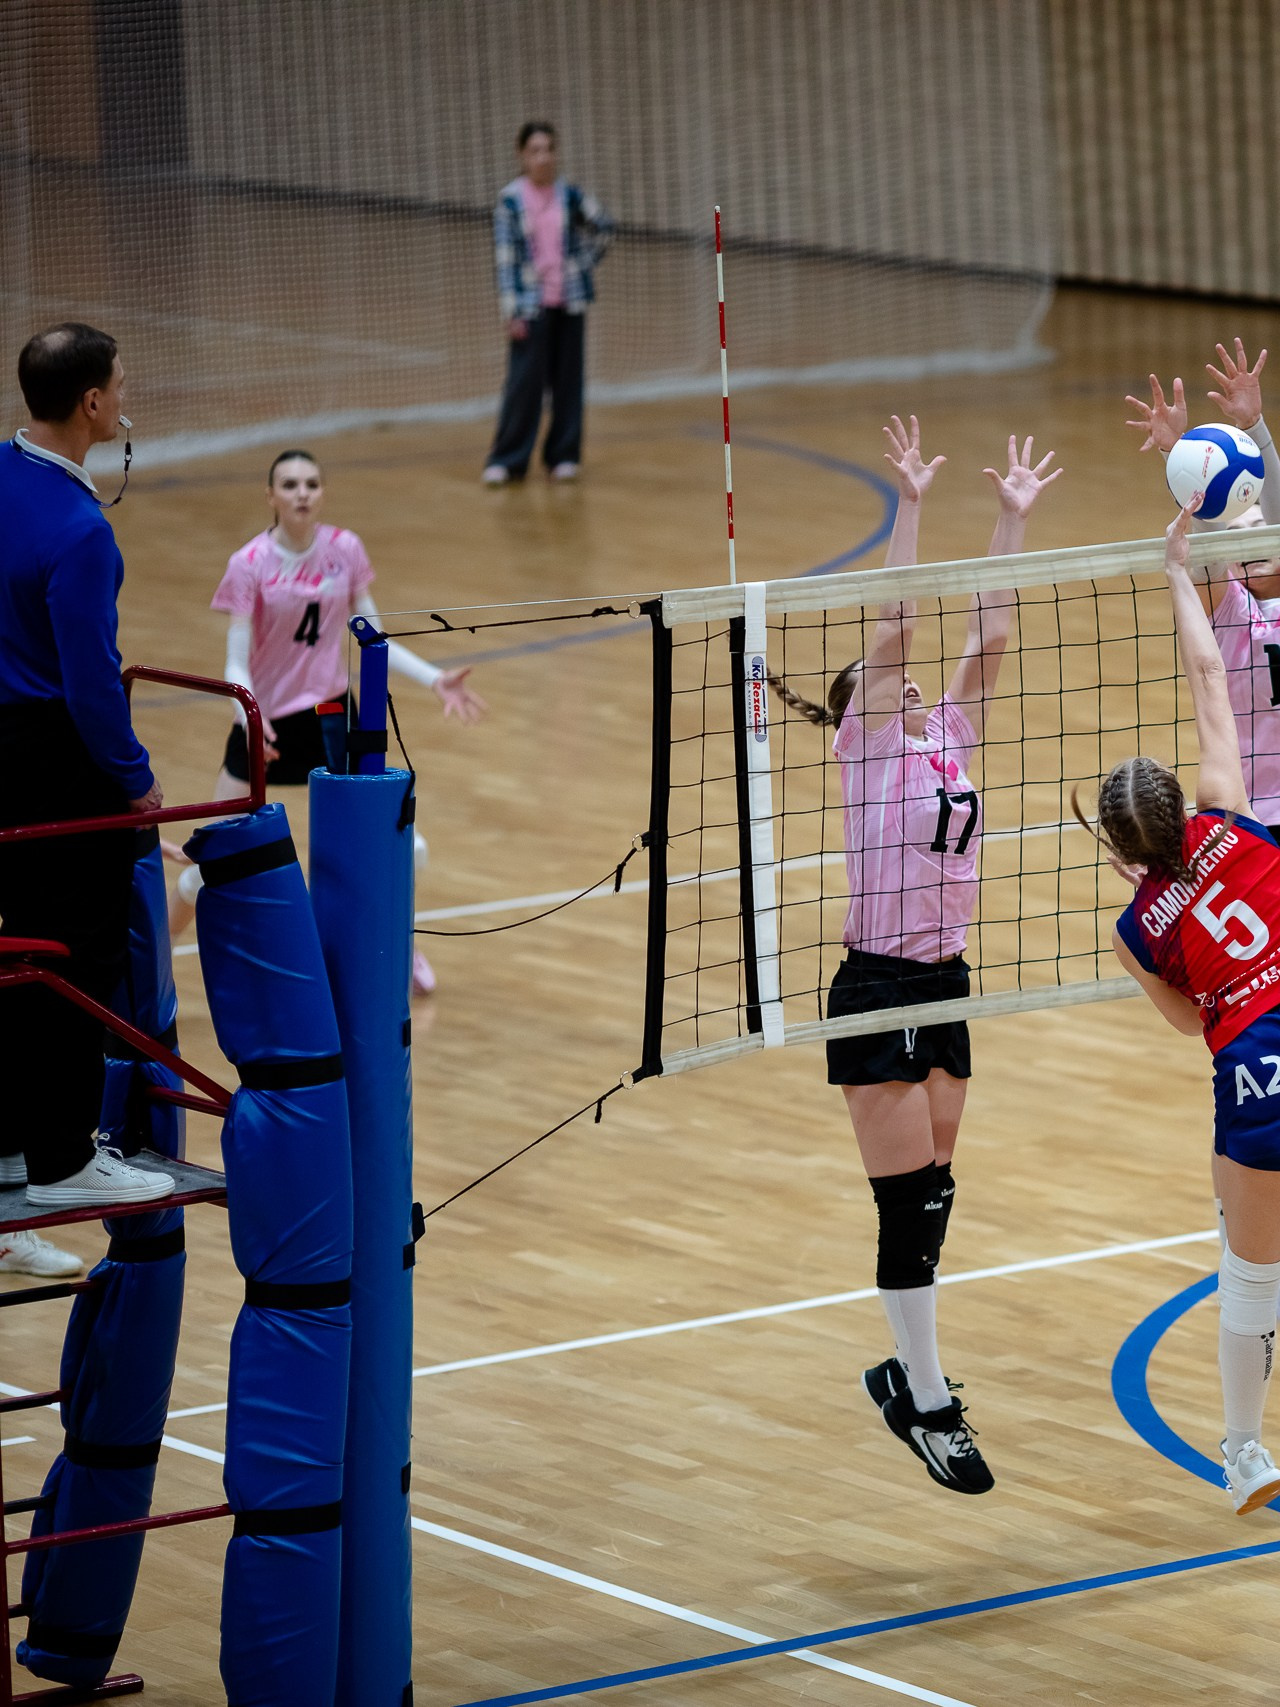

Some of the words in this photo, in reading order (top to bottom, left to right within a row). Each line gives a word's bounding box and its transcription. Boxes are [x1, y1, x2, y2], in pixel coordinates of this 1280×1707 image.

[293, 602, 320, 648] 4
[930, 788, 979, 855] 17
[1191, 880, 1270, 961] 5
